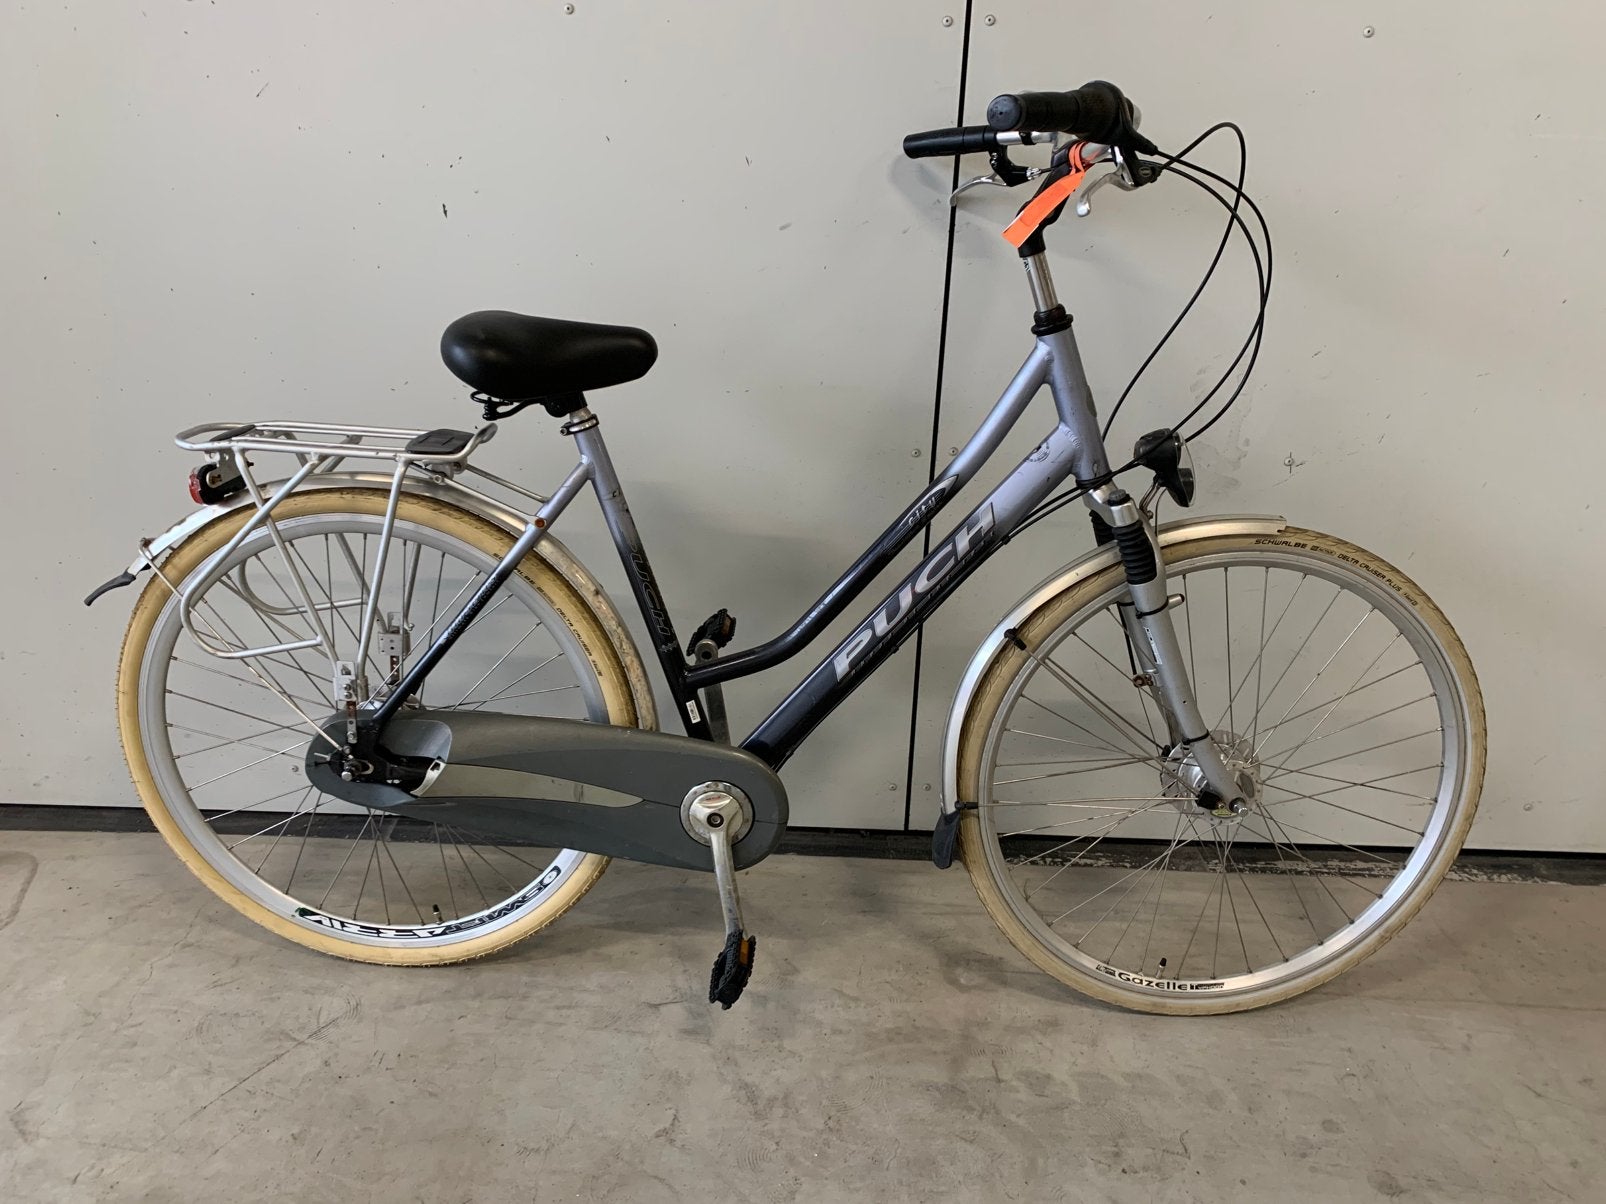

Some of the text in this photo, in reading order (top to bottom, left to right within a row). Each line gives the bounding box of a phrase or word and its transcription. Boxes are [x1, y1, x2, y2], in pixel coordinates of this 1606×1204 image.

[908, 496, 937, 526] city
[1254, 538, 1403, 593] SCHWALBE DELTA CRUISER PLUS
[833, 502, 995, 683] PUCH
[1118, 972, 1188, 991] Gazelle
